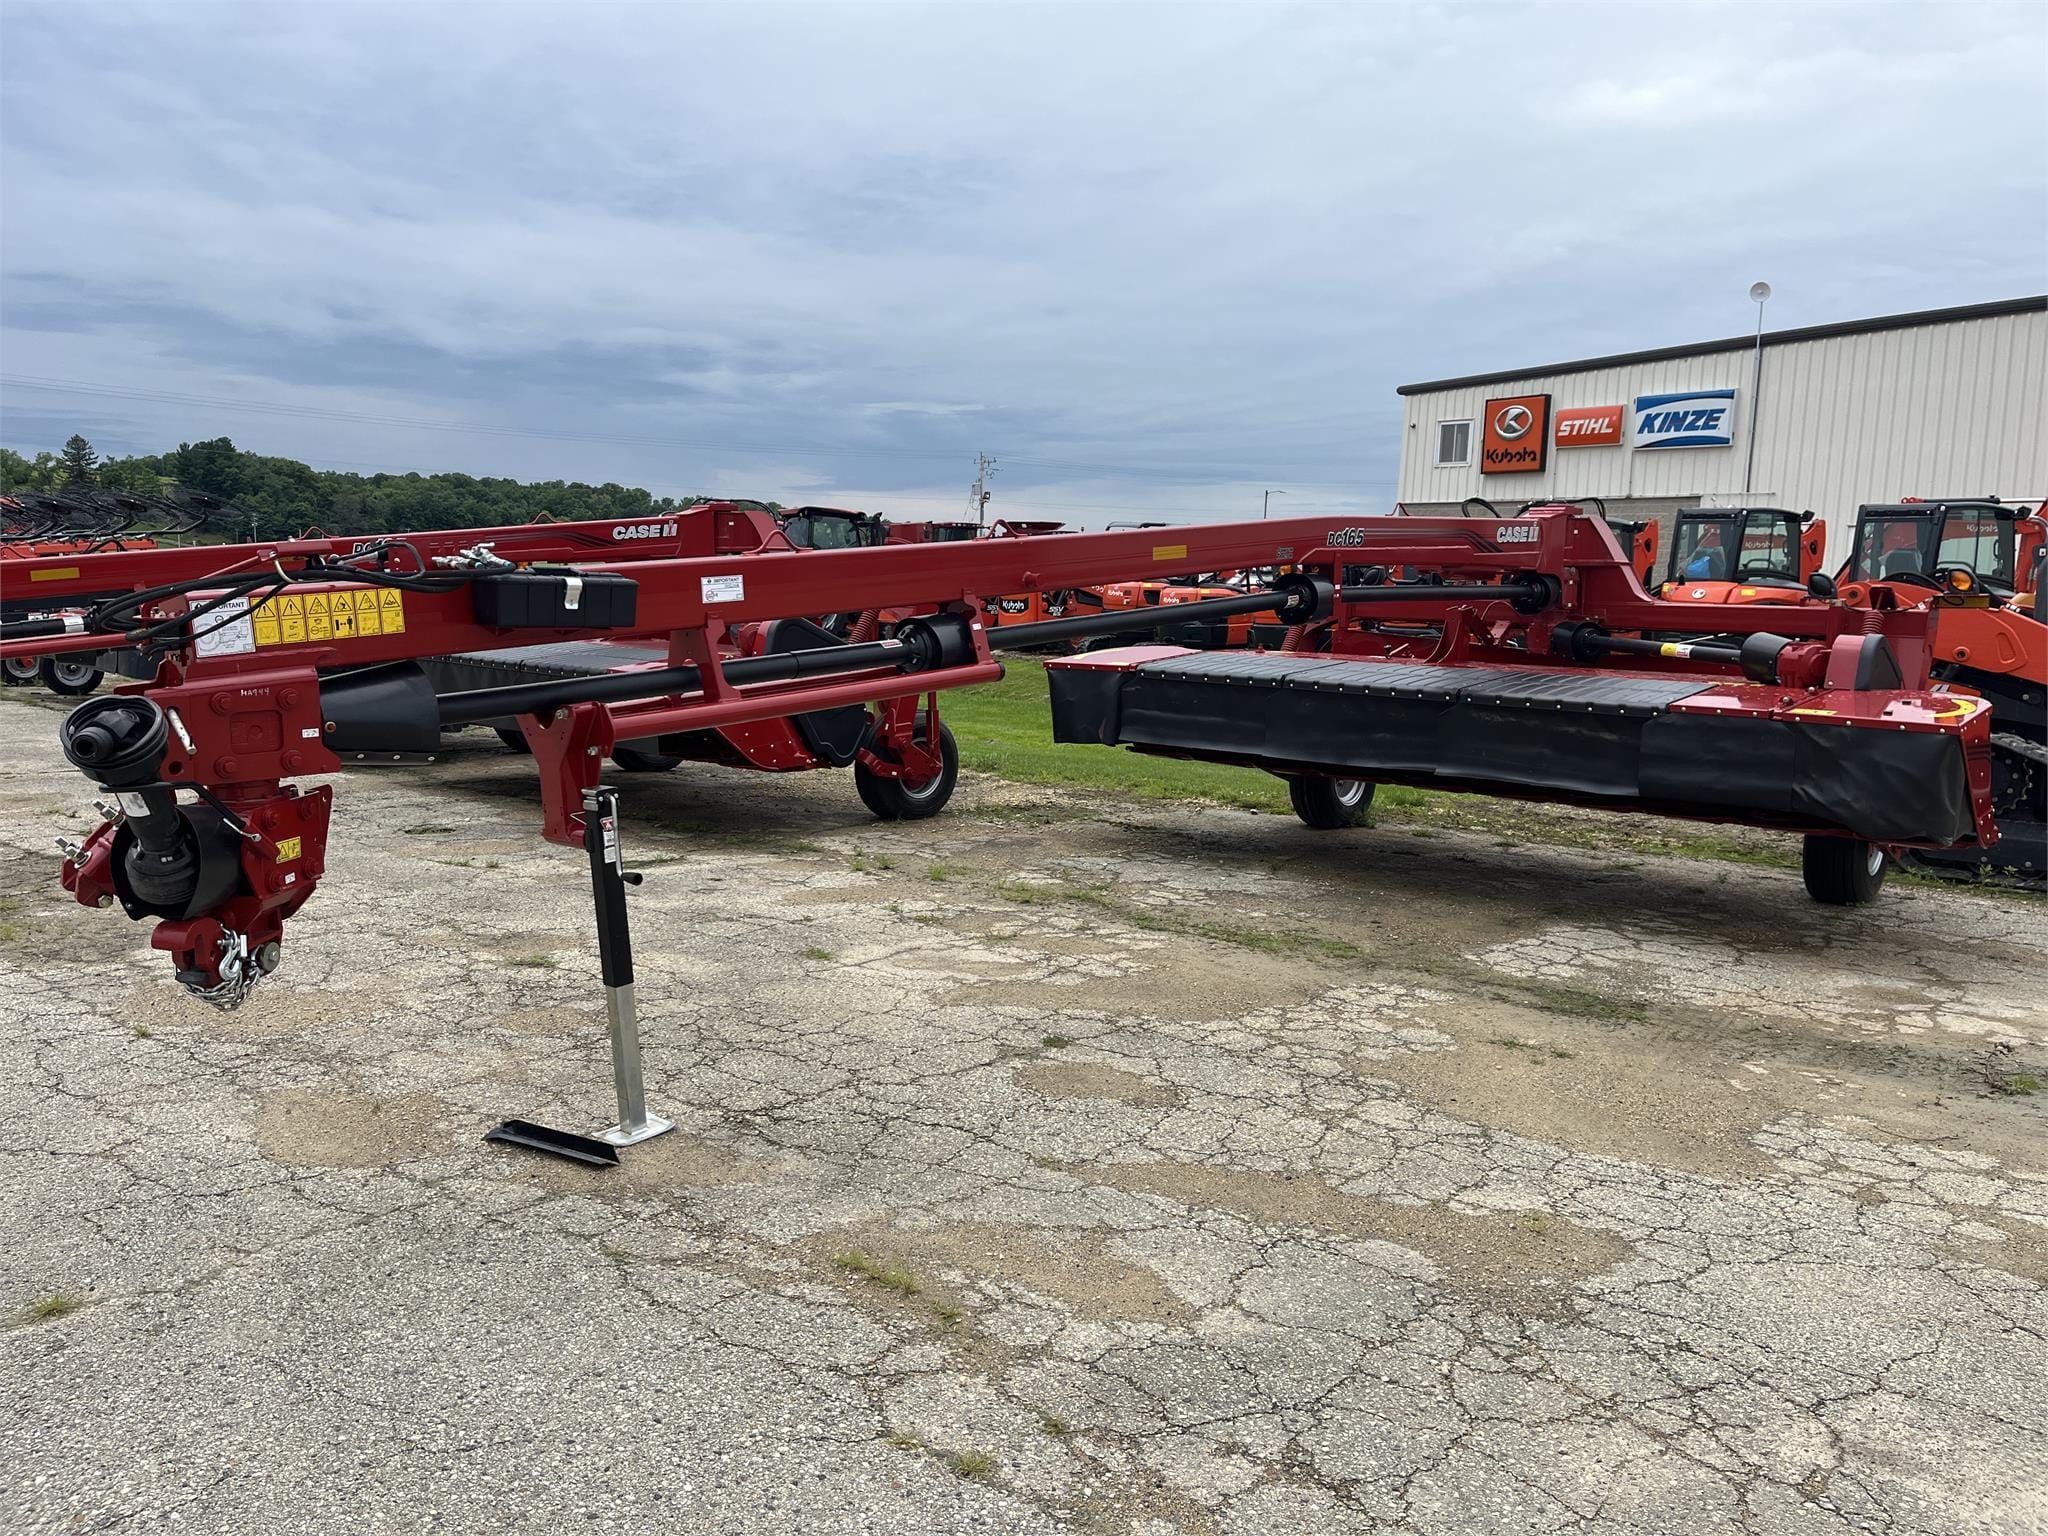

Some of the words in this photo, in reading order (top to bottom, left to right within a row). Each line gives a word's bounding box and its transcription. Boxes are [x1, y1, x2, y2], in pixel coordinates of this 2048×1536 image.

[1557, 417, 1614, 437] STIHL
[1637, 408, 1727, 434] KINZE
[1486, 446, 1537, 463] Kubota
[612, 525, 661, 540] CASE
[1327, 528, 1365, 546] DC165
[1496, 526, 1529, 543] CASE
[1002, 600, 1025, 610] Kubota
[1048, 605, 1065, 613] SSV
